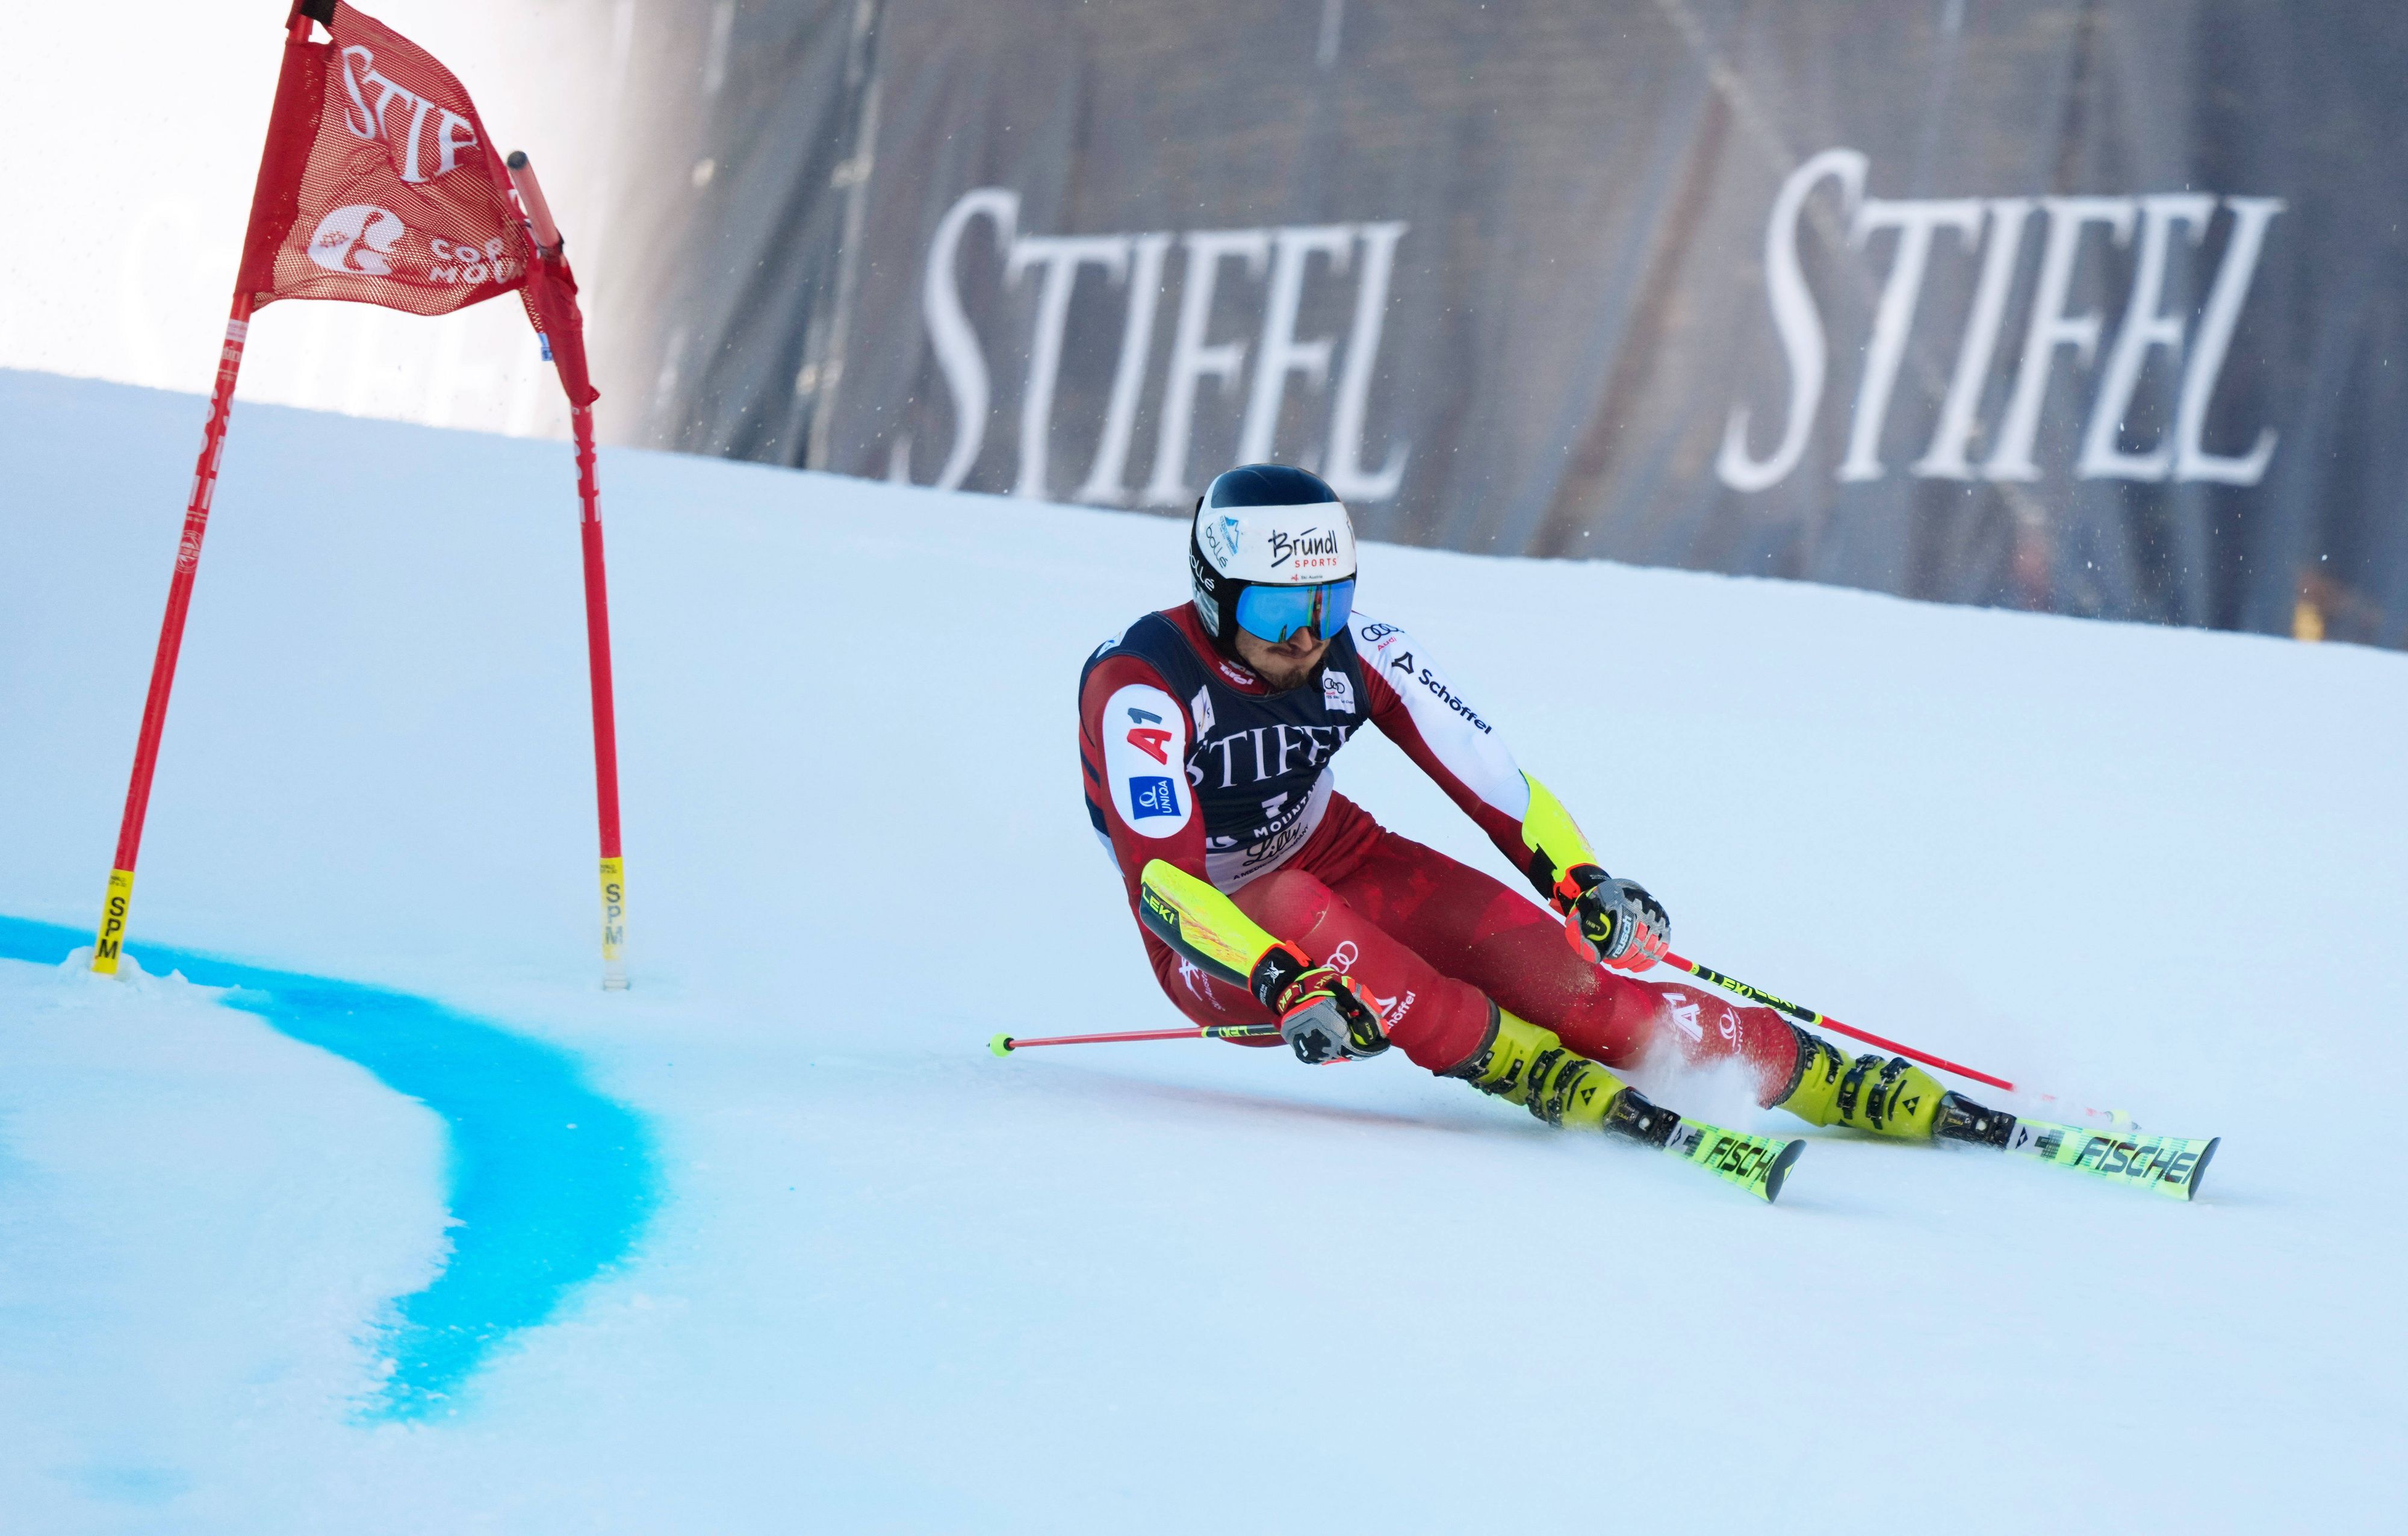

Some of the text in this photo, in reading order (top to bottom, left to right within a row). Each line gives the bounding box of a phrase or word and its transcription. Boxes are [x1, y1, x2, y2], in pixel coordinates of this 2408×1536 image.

[1715, 146, 2287, 493] STIFEL
[887, 186, 1411, 506] STIFEL
[1206, 522, 1228, 569] bollé
[1294, 558, 1336, 568] SPORTS
[1377, 636, 1397, 651] Audi
[1219, 662, 1254, 685] Tirol
[1127, 707, 1172, 765] A1
[1158, 780, 1173, 813] UNIQA
[606, 883, 623, 945] SPM
[1143, 886, 1175, 924] LEKI
[98, 897, 125, 959] SPM
[1612, 915, 1633, 958] reusch
[1708, 971, 1753, 997] LEKI
[1386, 990, 1416, 1030] höffel
[1662, 992, 1703, 1043] A1
[2074, 1137, 2200, 1185] FISCHE
